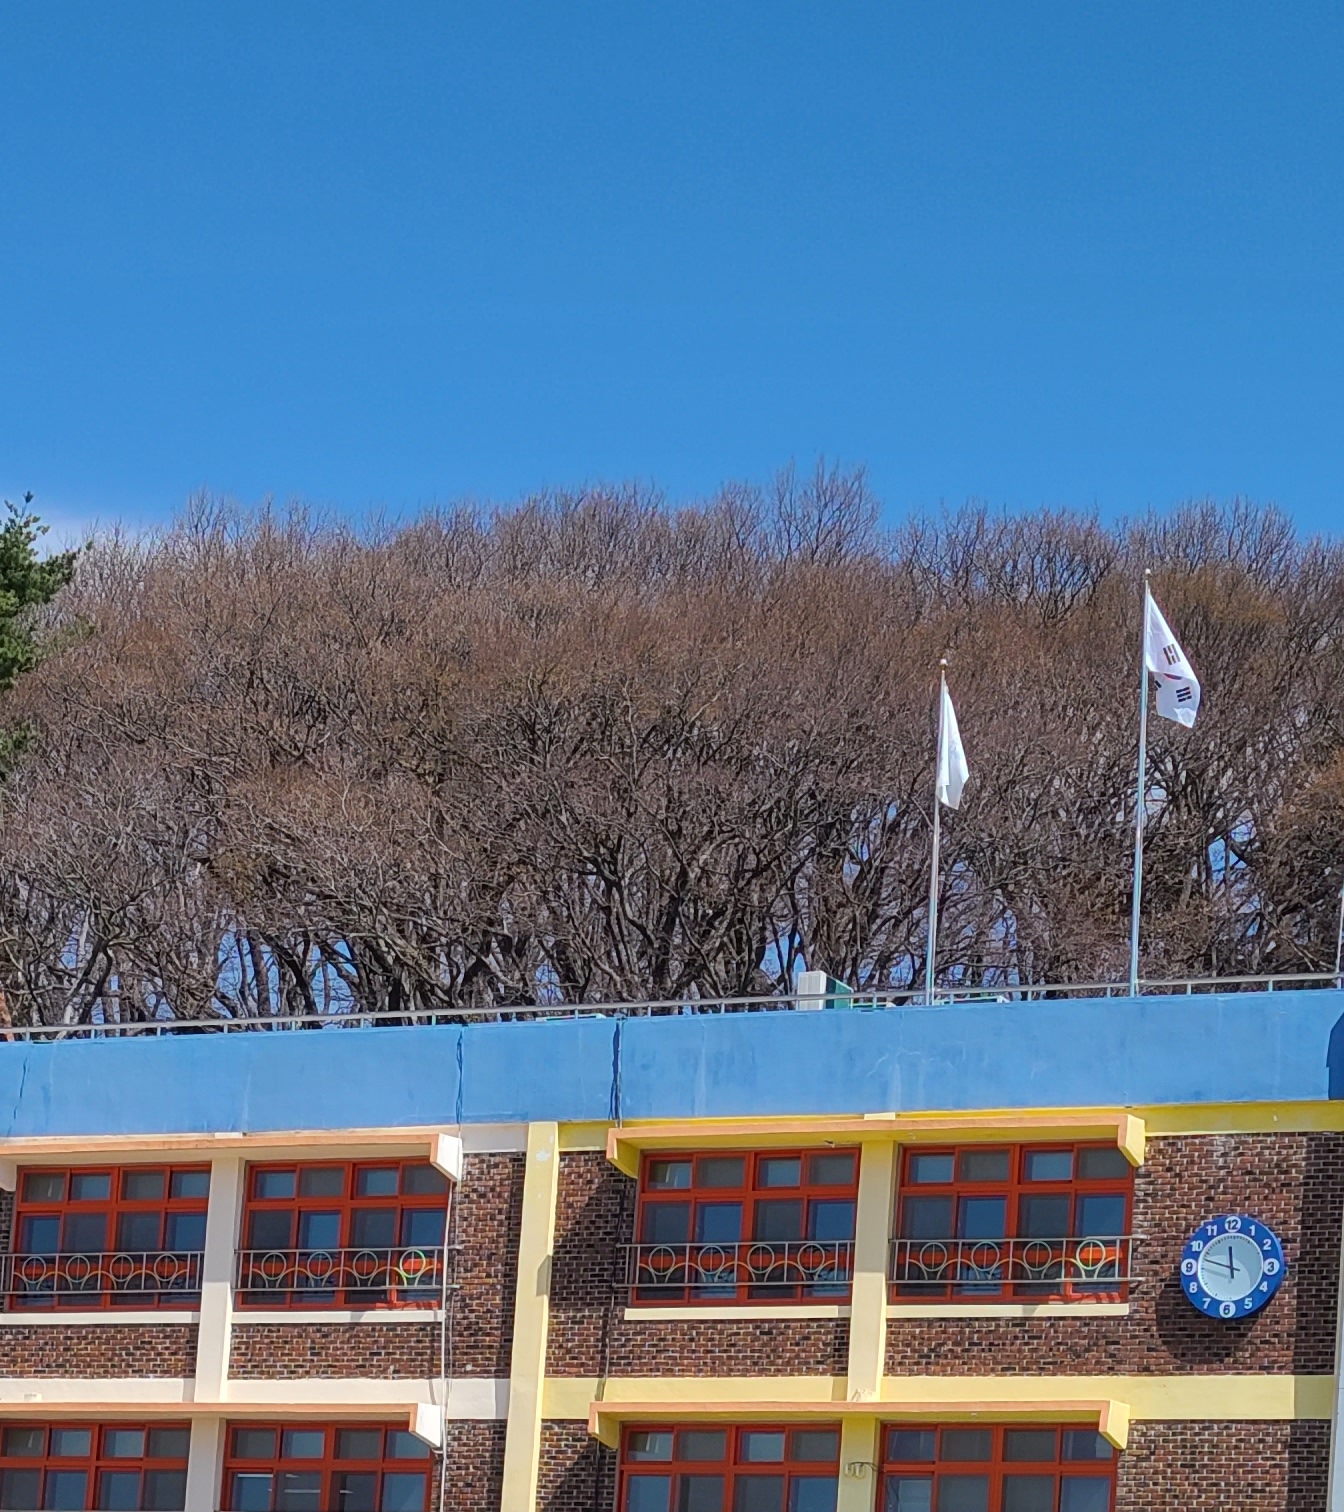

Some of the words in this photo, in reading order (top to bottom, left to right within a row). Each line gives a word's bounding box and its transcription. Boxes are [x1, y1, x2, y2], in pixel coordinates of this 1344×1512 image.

[1206, 1225, 1217, 1236] 11
[1226, 1220, 1240, 1230] 12
[1249, 1225, 1256, 1236] 1
[1190, 1241, 1204, 1252] 10
[1264, 1239, 1271, 1250] 2
[1186, 1262, 1193, 1272] 9
[1268, 1262, 1275, 1272] 3
[1189, 1282, 1197, 1293] 8
[1260, 1282, 1268, 1292] 4
[1202, 1298, 1211, 1309] 7
[1244, 1298, 1252, 1309] 5
[1223, 1305, 1230, 1315] 6
